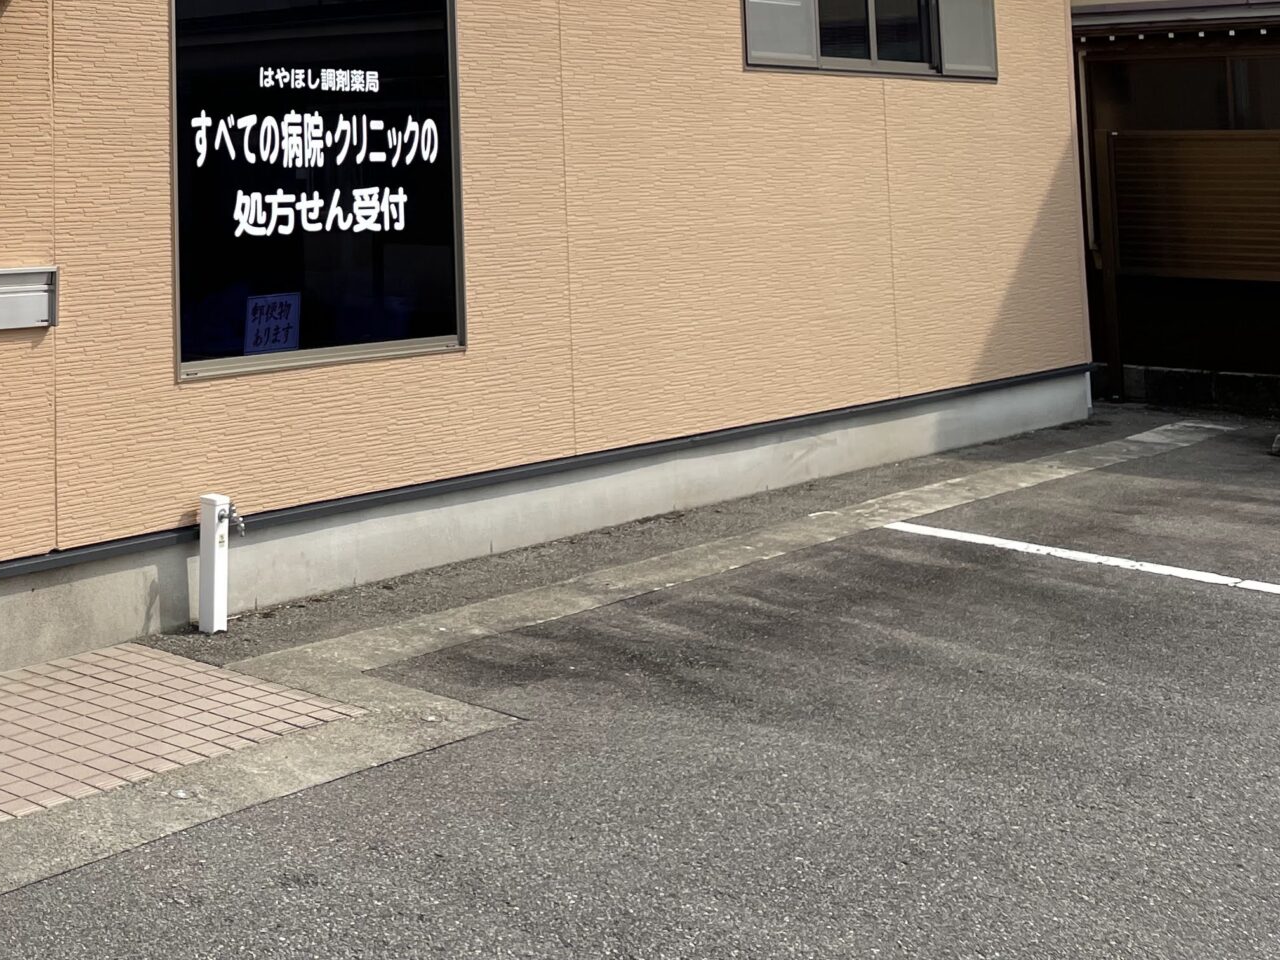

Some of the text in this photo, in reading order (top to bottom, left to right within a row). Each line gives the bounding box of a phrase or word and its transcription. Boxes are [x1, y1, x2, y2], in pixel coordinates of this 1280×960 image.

[259, 66, 379, 93] はやほし調剤薬局
[190, 109, 439, 169] すべての病院・クリニックの
[233, 187, 408, 237] 処方せん受付
[252, 322, 294, 347] あります
